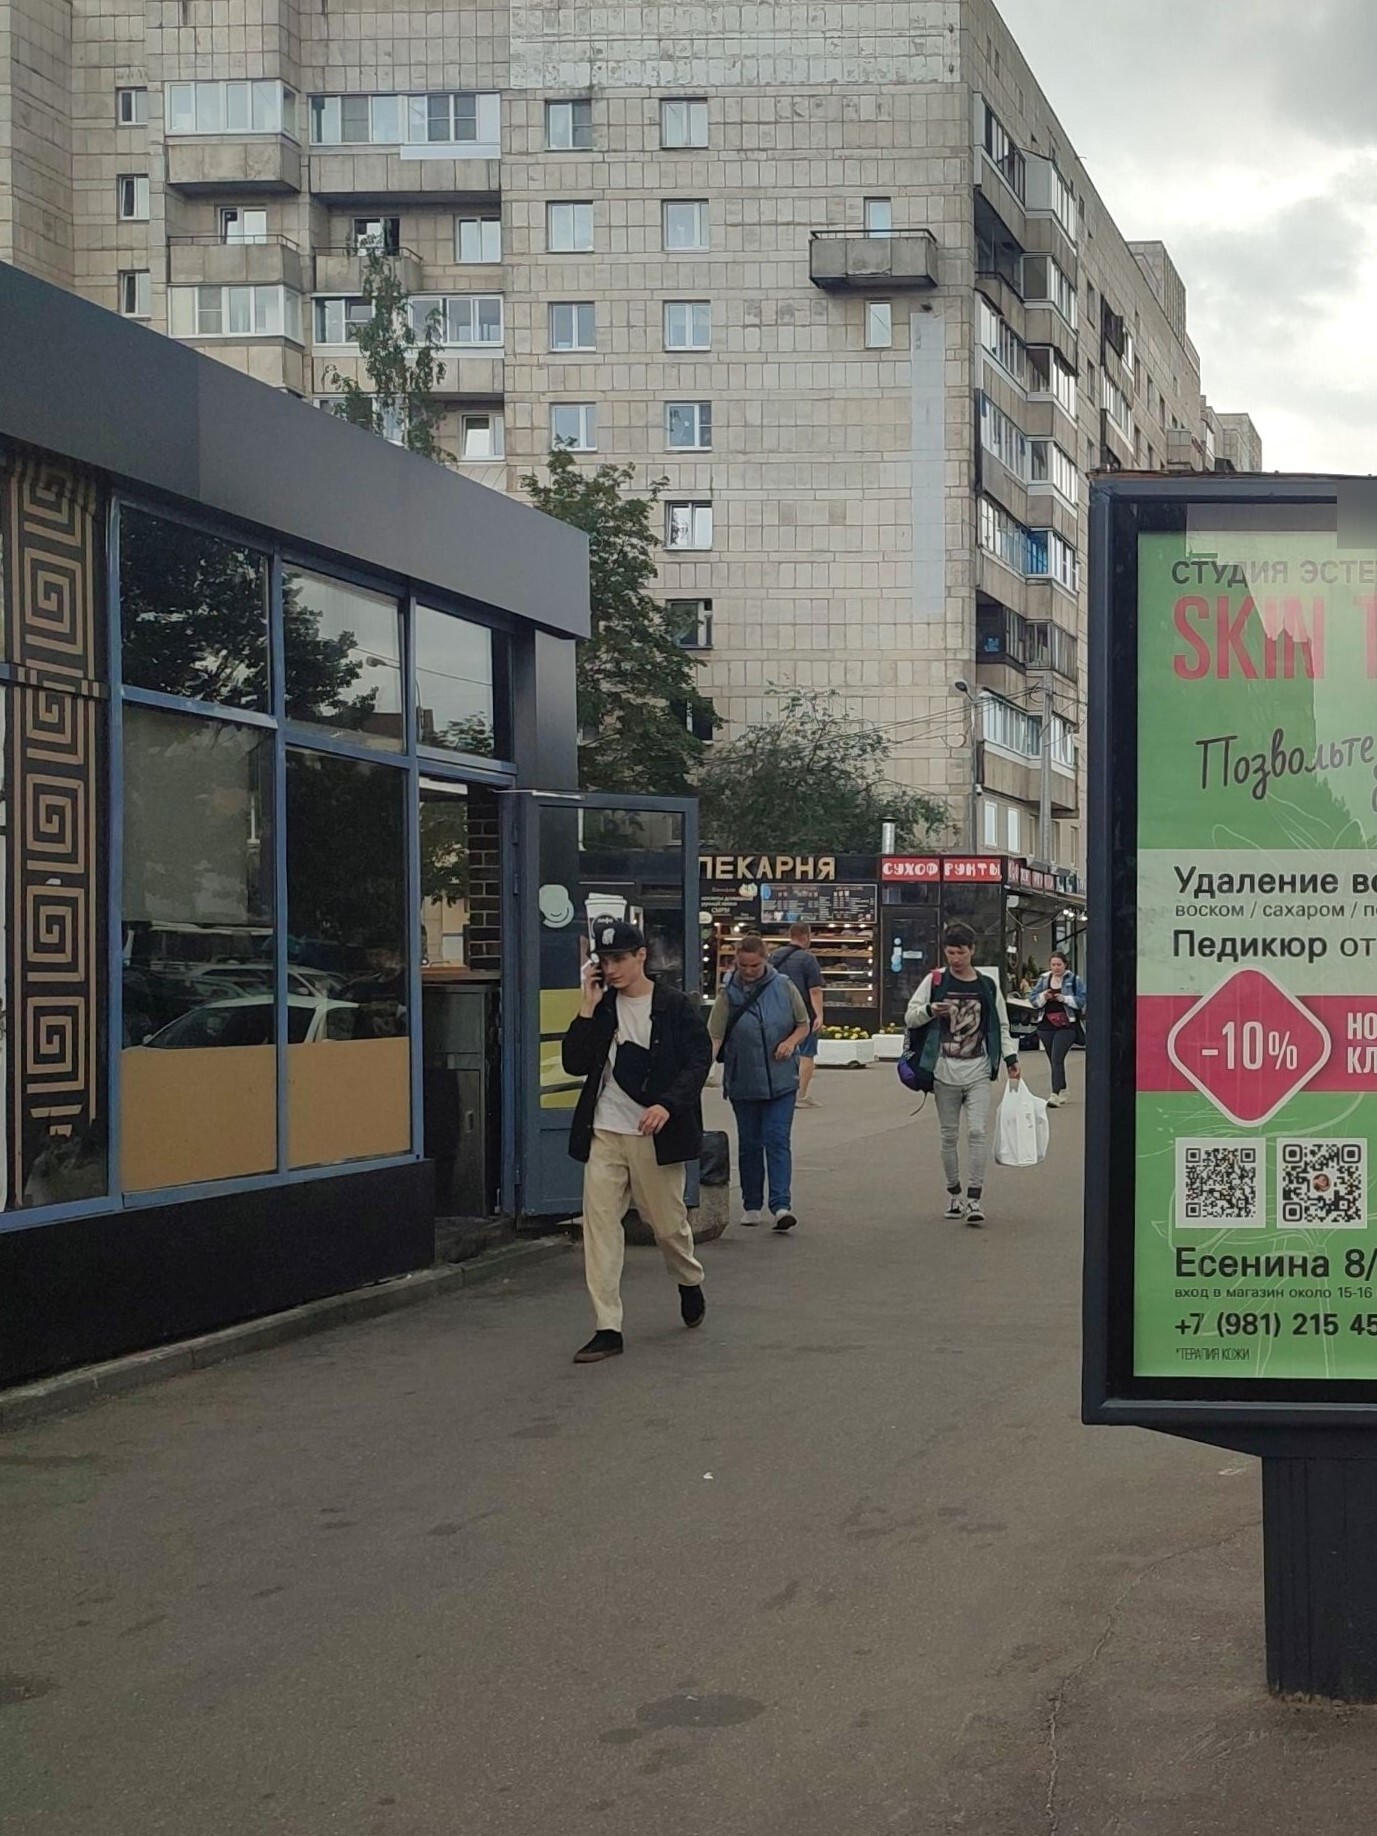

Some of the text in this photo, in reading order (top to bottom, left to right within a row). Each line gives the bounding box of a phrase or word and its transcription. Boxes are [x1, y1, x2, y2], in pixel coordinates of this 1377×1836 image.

[1171, 560, 1288, 588] СТУДИЯ
[1173, 596, 1325, 680] SKIN
[1195, 728, 1376, 800] Позвольте
[1174, 865, 1339, 898] Удаление
[1175, 904, 1244, 917] воском
[1262, 904, 1345, 919] сахаром
[1173, 929, 1328, 963] Педикюр
[1340, 937, 1377, 957] от
[1201, 1020, 1298, 1070] -10%
[1175, 1246, 1330, 1278] Есенина
[1174, 1288, 1209, 1300] вход
[1213, 1288, 1221, 1299] в
[1226, 1288, 1284, 1299] магазин
[1289, 1288, 1332, 1299] около
[1337, 1287, 1373, 1299] 15-16
[1175, 1313, 1205, 1335] +7
[1216, 1311, 1281, 1338] (981)
[1292, 1313, 1339, 1336] 215
